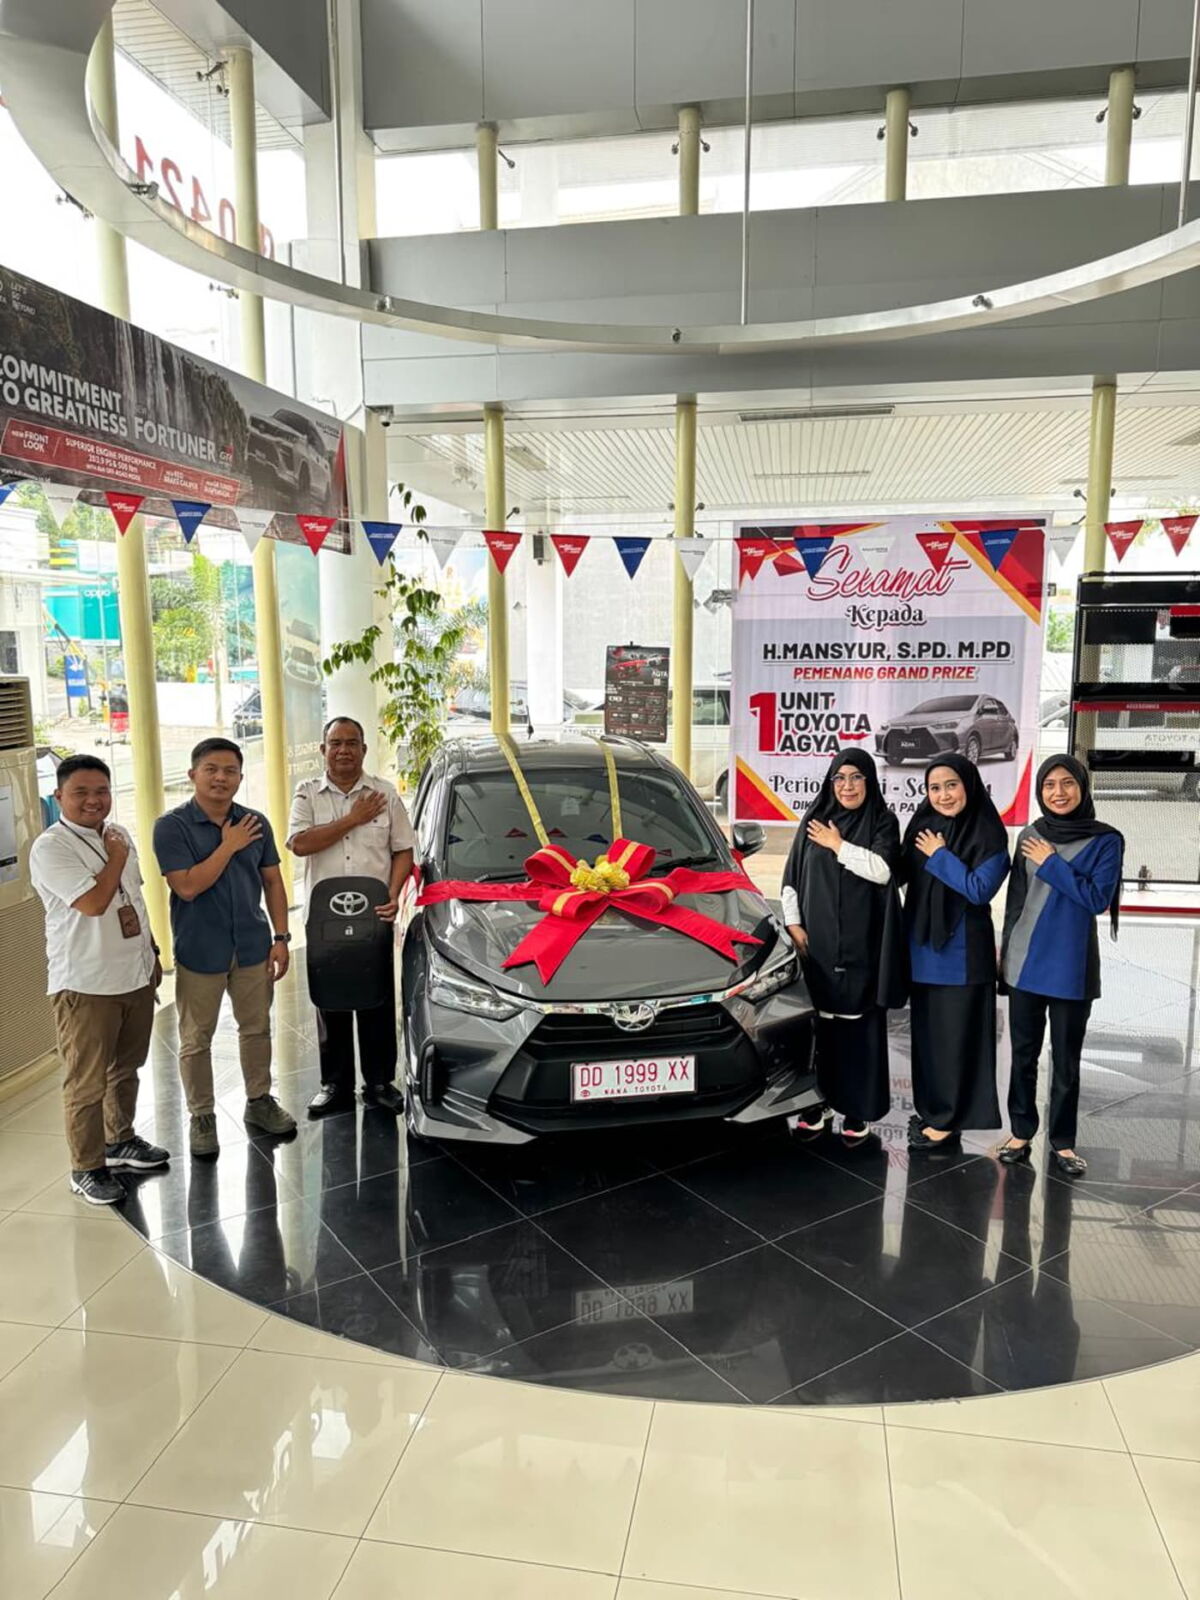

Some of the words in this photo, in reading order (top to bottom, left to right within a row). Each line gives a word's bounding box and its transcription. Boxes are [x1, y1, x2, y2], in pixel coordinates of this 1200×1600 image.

[0, 379, 20, 406] O
[24, 387, 128, 437] GREATNESS
[134, 416, 217, 463] FORTUNER
[23, 439, 45, 453] LOOK
[24, 430, 49, 445] FRONT
[65, 437, 95, 453] SUPERIOR
[95, 445, 117, 459] ENGINE
[846, 605, 924, 629] Kepada
[763, 642, 891, 661] H.MANSYUR,
[897, 642, 951, 659] S.PD.
[958, 641, 1011, 658] M.PD
[793, 666, 874, 680] PEMENANG
[878, 666, 929, 680] GRAND
[932, 665, 976, 679] PRIZE
[750, 692, 777, 752] 1
[781, 692, 833, 710] UNIT
[781, 713, 871, 732] TOYOTA
[780, 734, 840, 753] AGYA
[769, 775, 820, 794] Perio
[580, 1066, 602, 1087] DD
[615, 1062, 658, 1085] 1999
[668, 1061, 689, 1081] XX
[635, 1085, 667, 1093] TOYOTA
